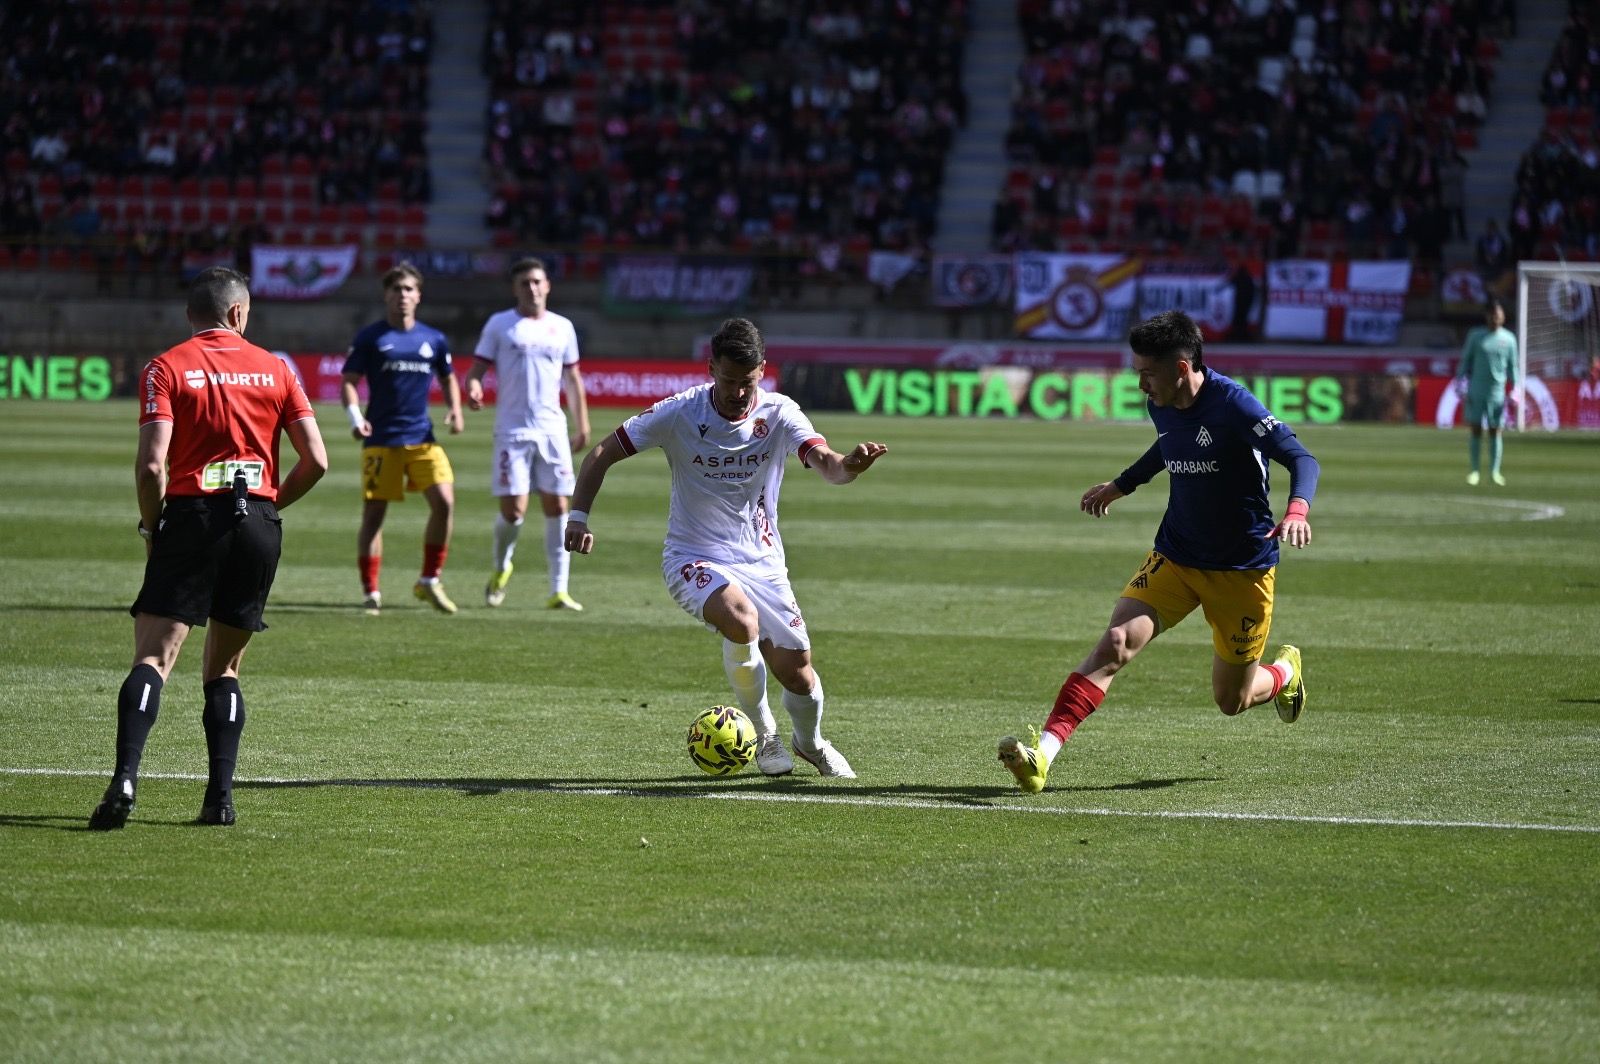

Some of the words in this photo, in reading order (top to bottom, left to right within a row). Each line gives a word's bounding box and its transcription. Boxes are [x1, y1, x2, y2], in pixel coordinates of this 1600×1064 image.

[0, 356, 111, 400] NES
[845, 370, 1018, 416] VISITA
[692, 450, 770, 468] ASPIRE
[703, 470, 757, 479] ACADEM
